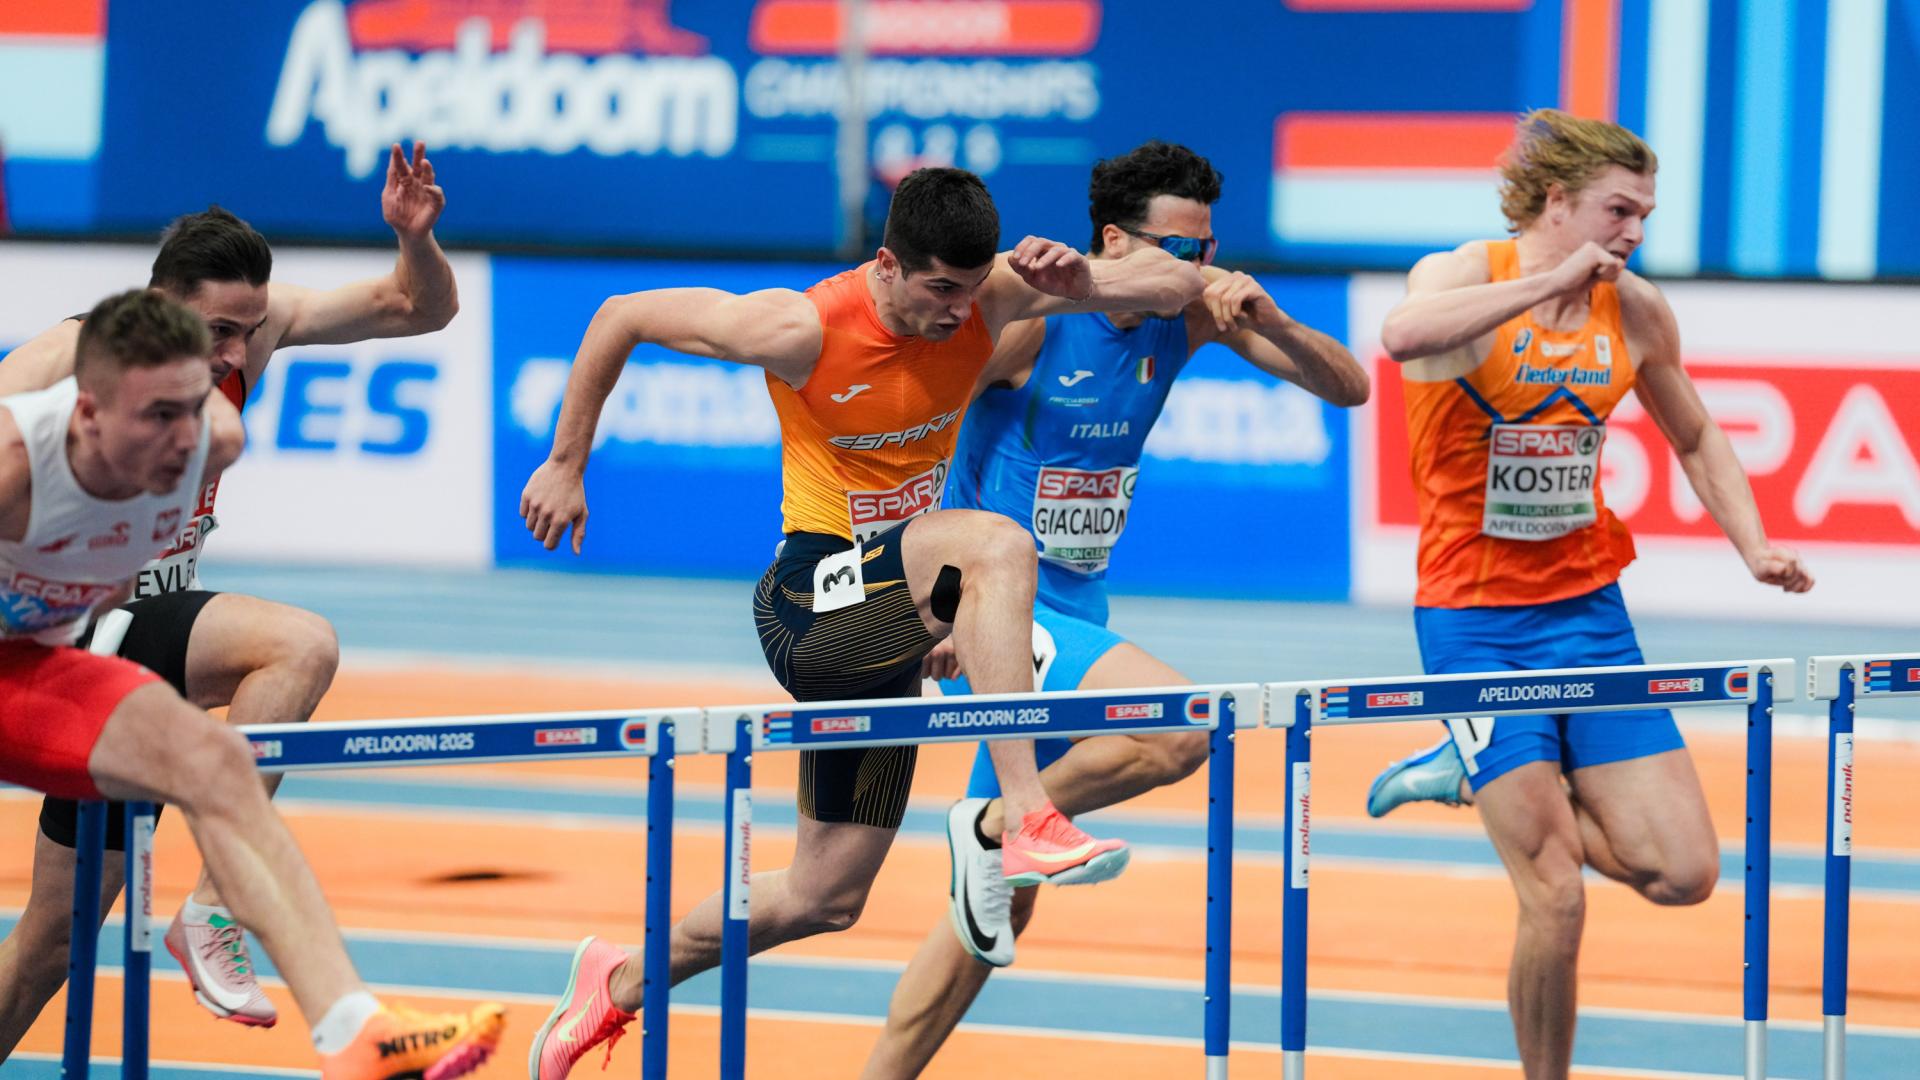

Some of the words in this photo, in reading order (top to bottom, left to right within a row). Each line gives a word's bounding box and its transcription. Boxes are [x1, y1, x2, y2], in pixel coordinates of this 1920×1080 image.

[1069, 421, 1129, 438] ITALIA
[1496, 432, 1576, 454] SPAR
[1041, 474, 1118, 497] SPAR
[1492, 465, 1592, 492] KOSTER
[853, 480, 934, 520] SPAR
[822, 565, 856, 594] 3
[1478, 684, 1561, 703] APELDOORN
[1562, 682, 1594, 698] 2025
[1658, 680, 1690, 691] SPAR
[1376, 695, 1410, 706] SPAR
[928, 709, 1015, 729] APELDOORN
[1016, 708, 1050, 725] 2025
[1115, 705, 1151, 718] SPAR
[821, 719, 857, 731] SPAR
[343, 734, 437, 755] APELDOORN
[438, 732, 475, 751] 2025
[377, 1015, 458, 1058] NITRO
